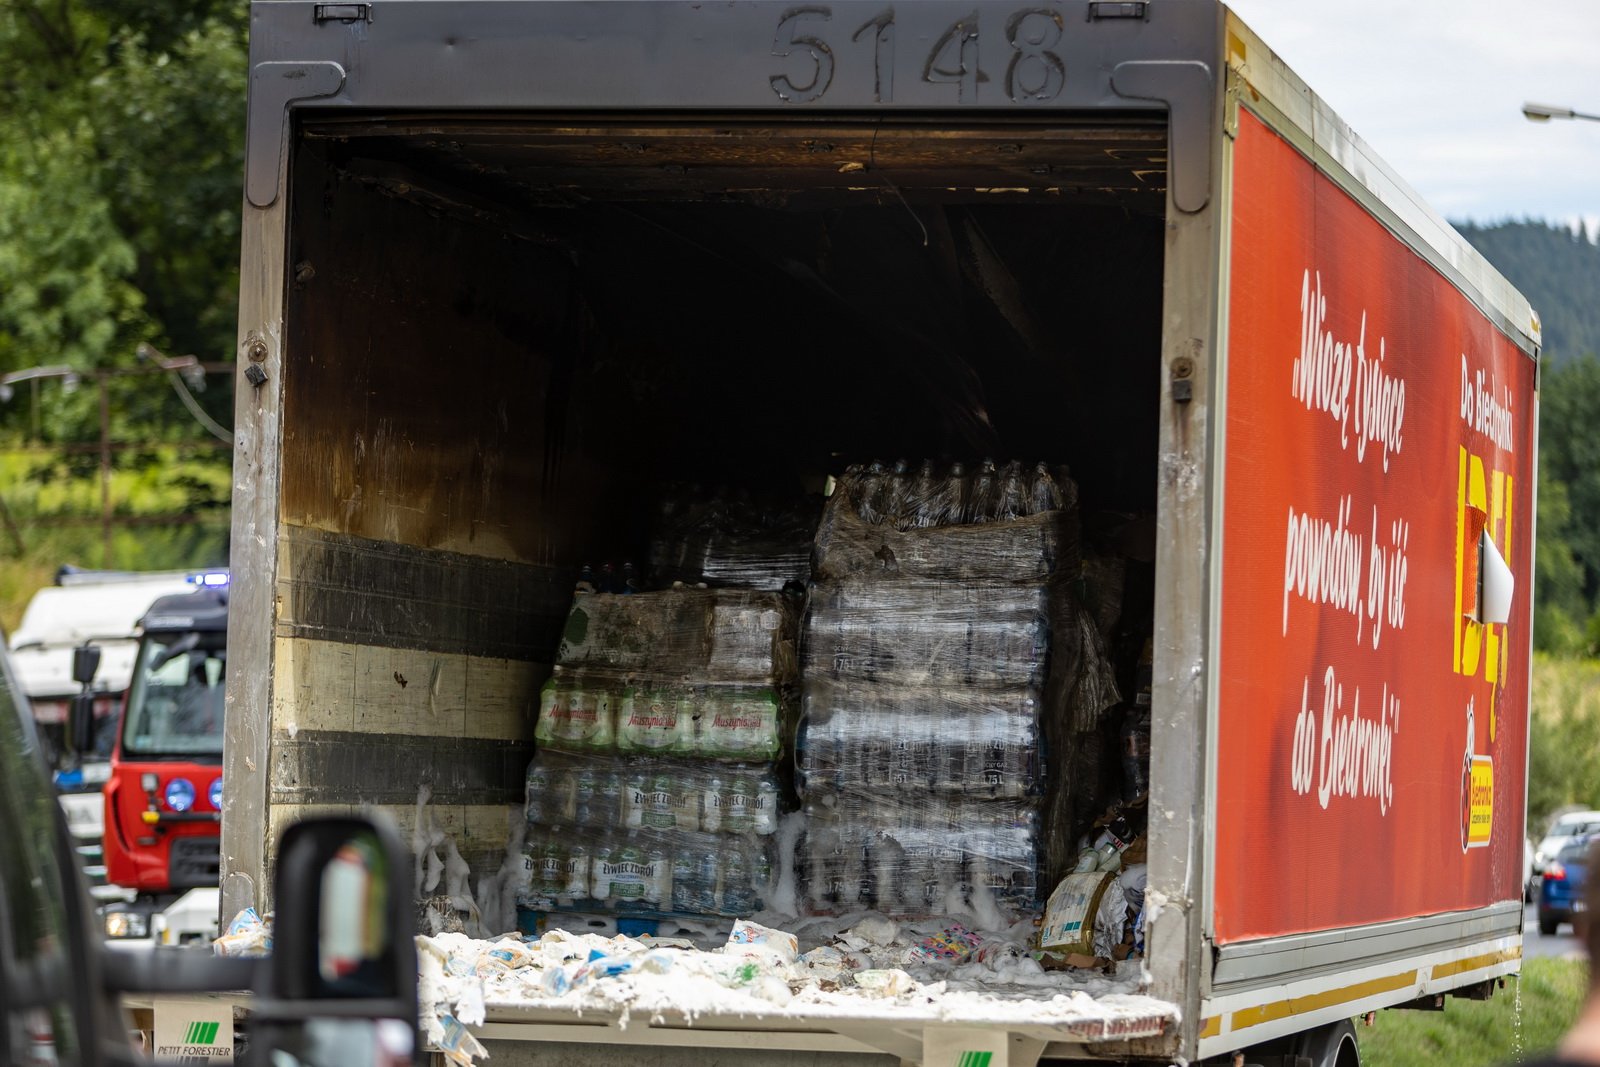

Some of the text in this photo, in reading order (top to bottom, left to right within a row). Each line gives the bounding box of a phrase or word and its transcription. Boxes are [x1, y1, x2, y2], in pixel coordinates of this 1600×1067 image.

[769, 5, 1065, 103] 5148
[1354, 309, 1405, 474] tysiące
[1460, 352, 1513, 453] Do Biedronki
[1282, 493, 1409, 650] powodów, by iść
[1291, 674, 1315, 795] do
[603, 863, 629, 875] ŻYWIEC
[630, 863, 654, 877] ZDRÓJ
[158, 1046, 231, 1056] PETIT FORESTIER
